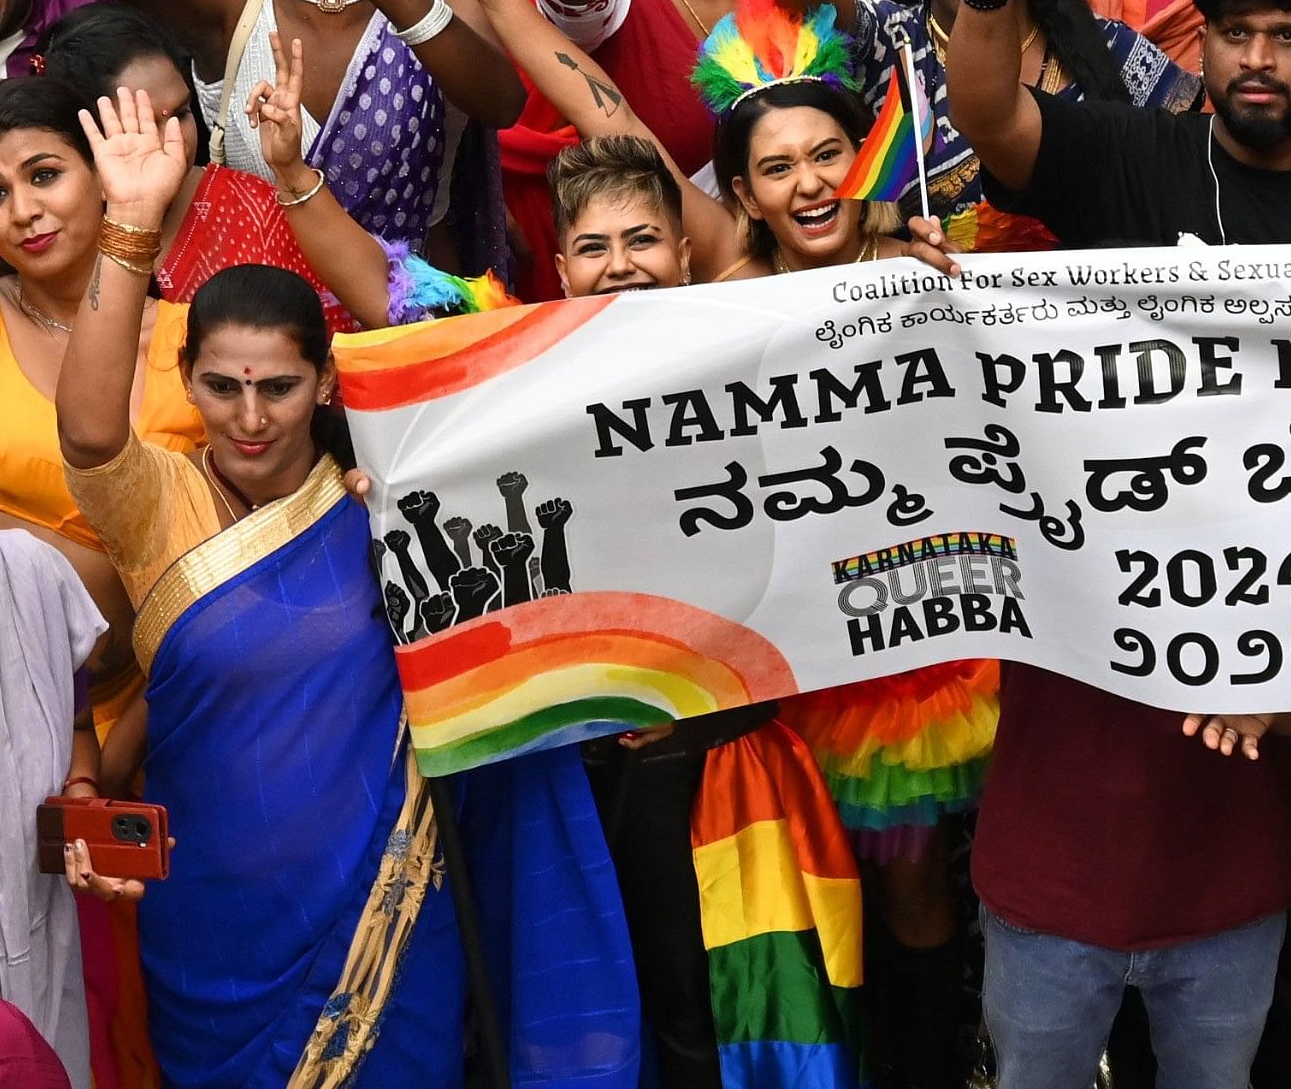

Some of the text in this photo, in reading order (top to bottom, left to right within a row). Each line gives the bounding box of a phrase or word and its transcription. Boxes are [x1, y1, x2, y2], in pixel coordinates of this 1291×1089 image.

[832, 273, 953, 303] Coalition
[959, 270, 1003, 291] For
[1011, 267, 1058, 287] Sex
[1066, 262, 1180, 286] Workers
[1188, 260, 1208, 281] &
[815, 312, 893, 349] ಲೈಂಗಿಕ
[1067, 295, 1131, 321] ಮತ್ತು
[1137, 293, 1215, 322] ಲೈಂಗಿಕ
[587, 347, 956, 458] NAMMA
[974, 335, 1243, 412] PRIDE
[674, 444, 934, 538] ನಮ್ಮ
[831, 532, 1018, 585] KARNATAKA
[838, 555, 1026, 617] QUEER
[847, 593, 1033, 656] HABBA
